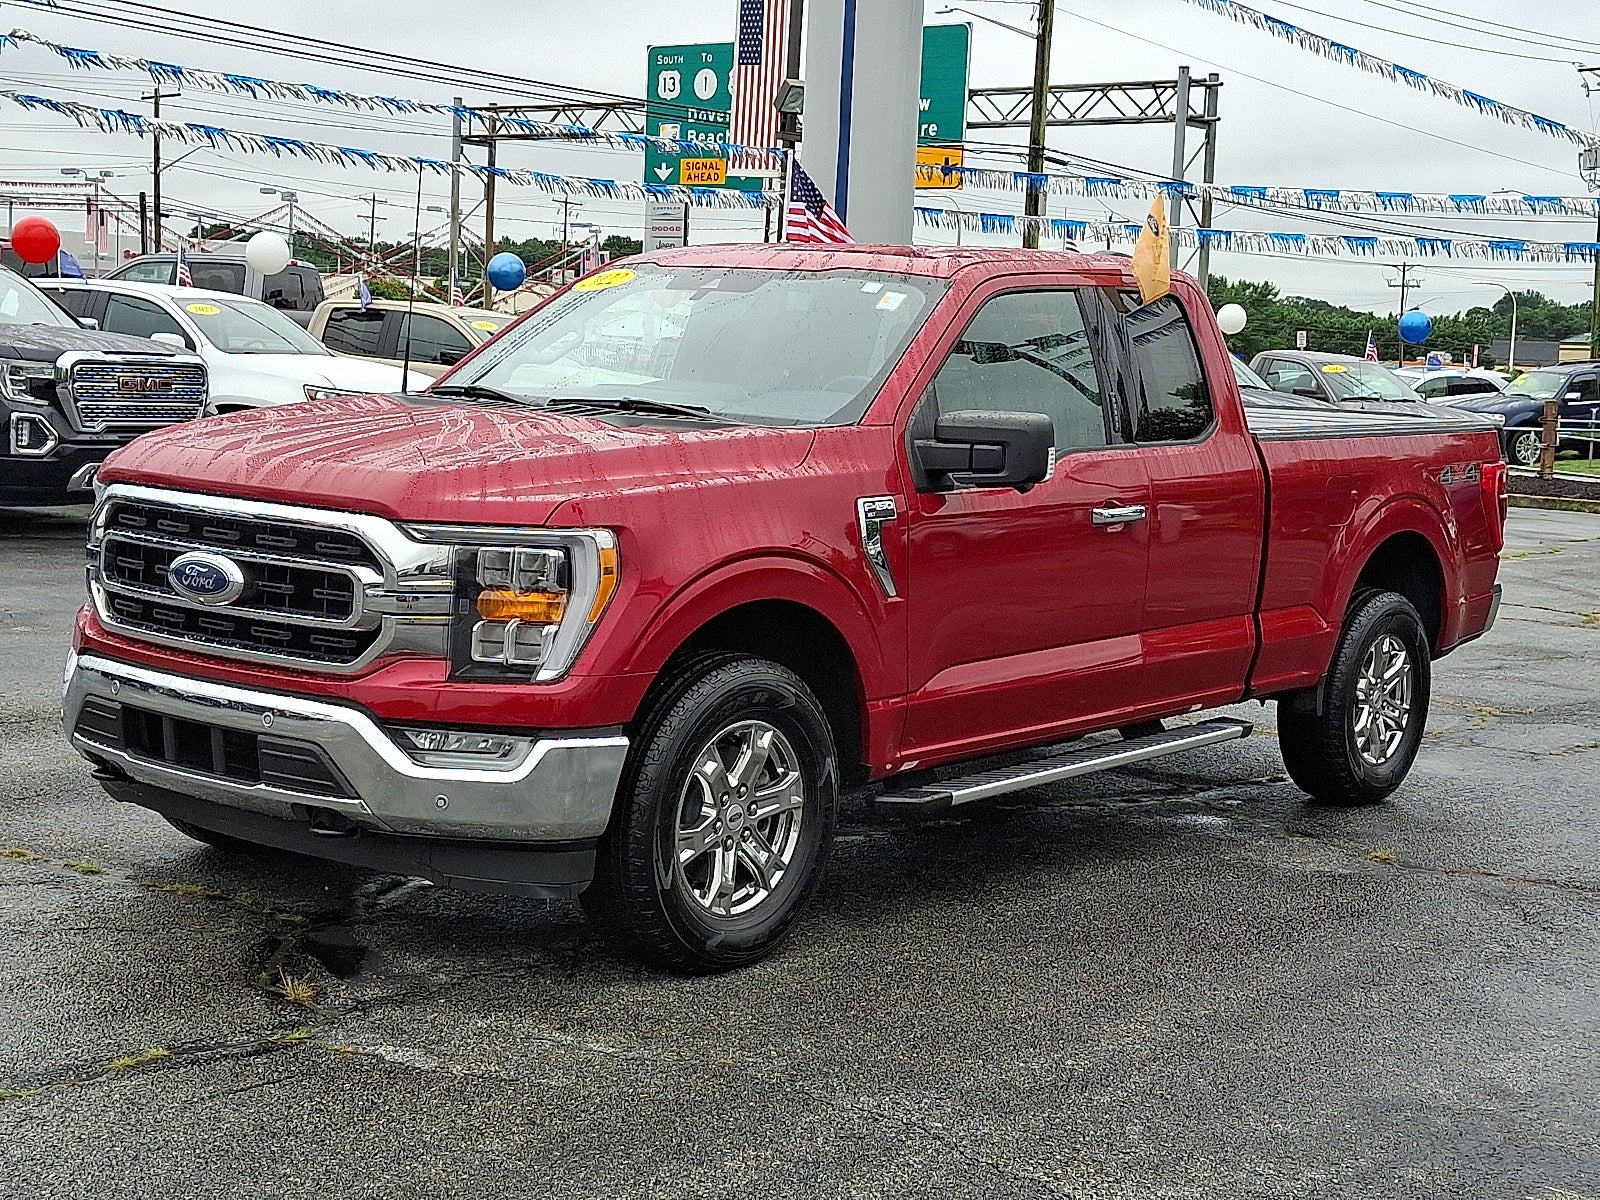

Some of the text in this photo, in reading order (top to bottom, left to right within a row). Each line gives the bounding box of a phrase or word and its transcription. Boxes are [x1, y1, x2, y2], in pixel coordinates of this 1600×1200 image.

[657, 54, 684, 65] SOUTH
[662, 76, 676, 93] 13
[685, 161, 721, 171] SIGNAL
[686, 172, 720, 182] AHEAD
[119, 376, 172, 391] GMC
[863, 500, 895, 512] F-150
[182, 564, 217, 590] Ford
